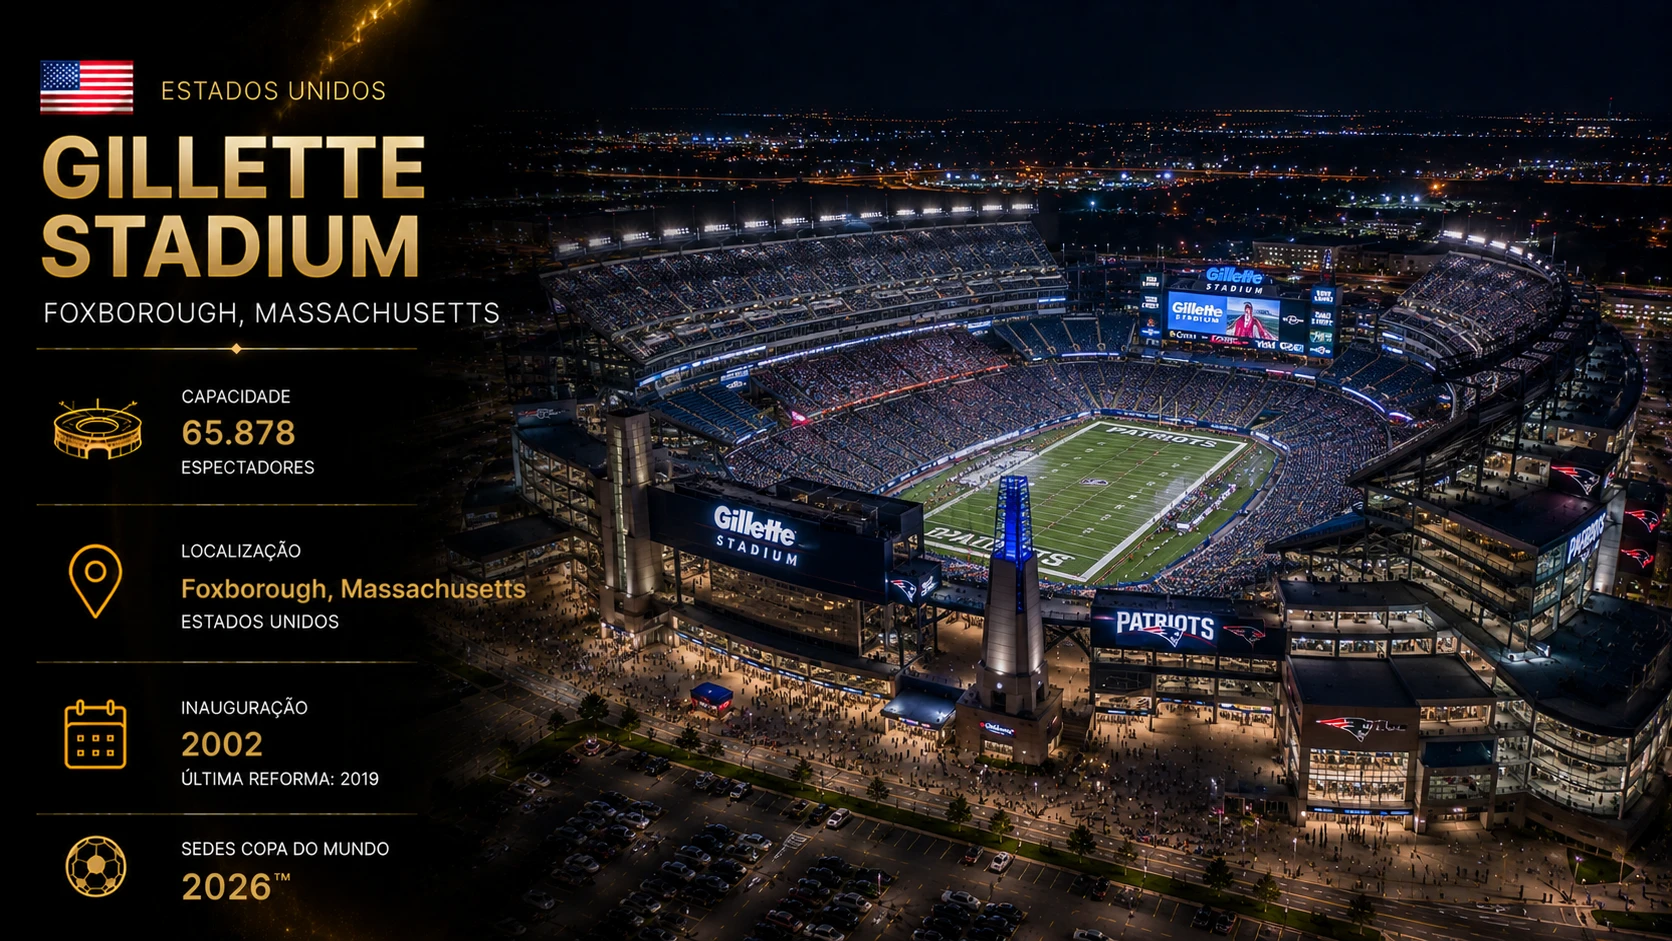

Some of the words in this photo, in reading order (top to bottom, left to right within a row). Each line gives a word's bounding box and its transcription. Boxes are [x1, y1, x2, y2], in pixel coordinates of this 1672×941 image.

[1206, 267, 1263, 285] Gillette
[1206, 283, 1263, 295] STADIUM
[1172, 301, 1224, 318] Gillette
[1106, 427, 1218, 448] PATRIOTS
[714, 505, 796, 546] Gillette
[716, 535, 798, 567] STADIUM
[1117, 611, 1215, 640] PATRIOTS
